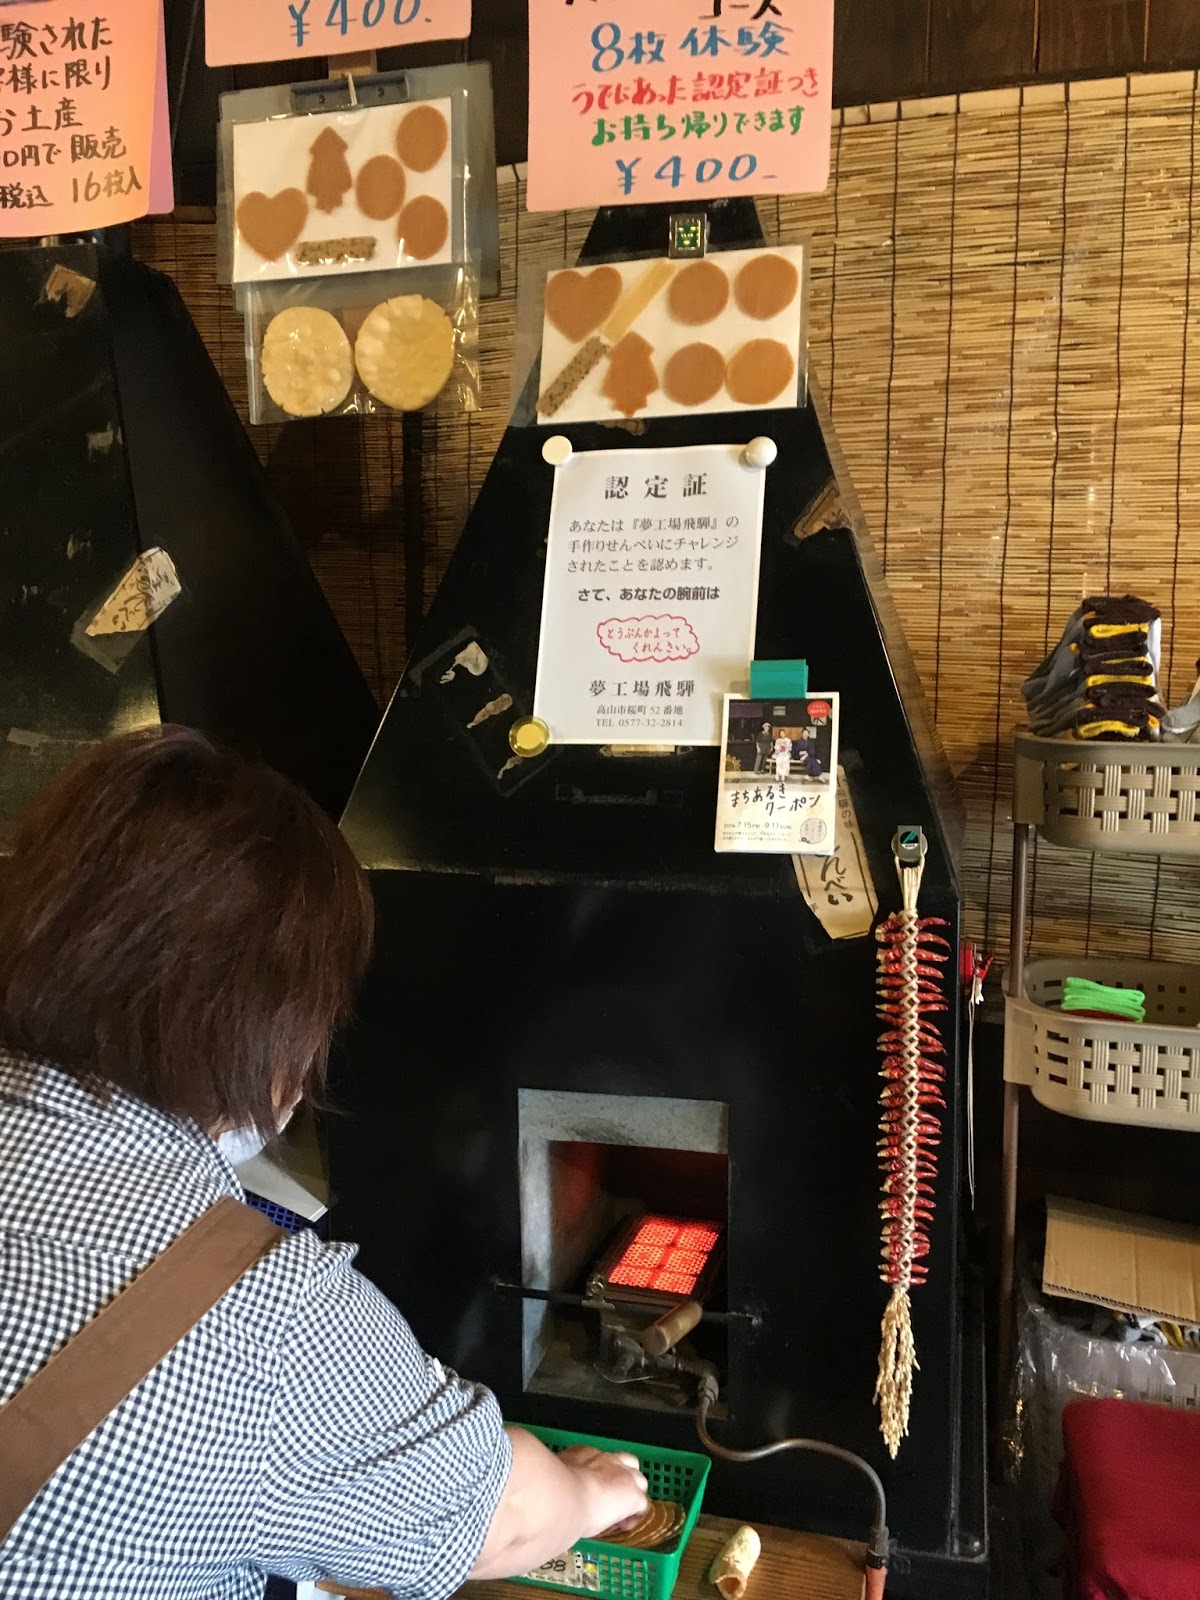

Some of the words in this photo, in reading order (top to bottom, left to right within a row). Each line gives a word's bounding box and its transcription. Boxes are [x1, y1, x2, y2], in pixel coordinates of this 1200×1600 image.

[0, 17, 113, 60] 験された
[591, 22, 666, 72] 8枚
[0, 55, 111, 95] 様に限り
[571, 66, 819, 115] うでにあった認定証つき
[591, 105, 805, 146] お持ち帰りできます
[567, 557, 713, 573] されたことを認めます。
[577, 586, 720, 602] さて、あなたの腕前は
[589, 680, 695, 698] 夢工場飛騨
[596, 719, 614, 727] TEL
[618, 718, 683, 727] 0577-32-2814
[731, 783, 786, 808] まちあるき
[766, 795, 820, 816] クーポン
[815, 846, 854, 906] んべい
